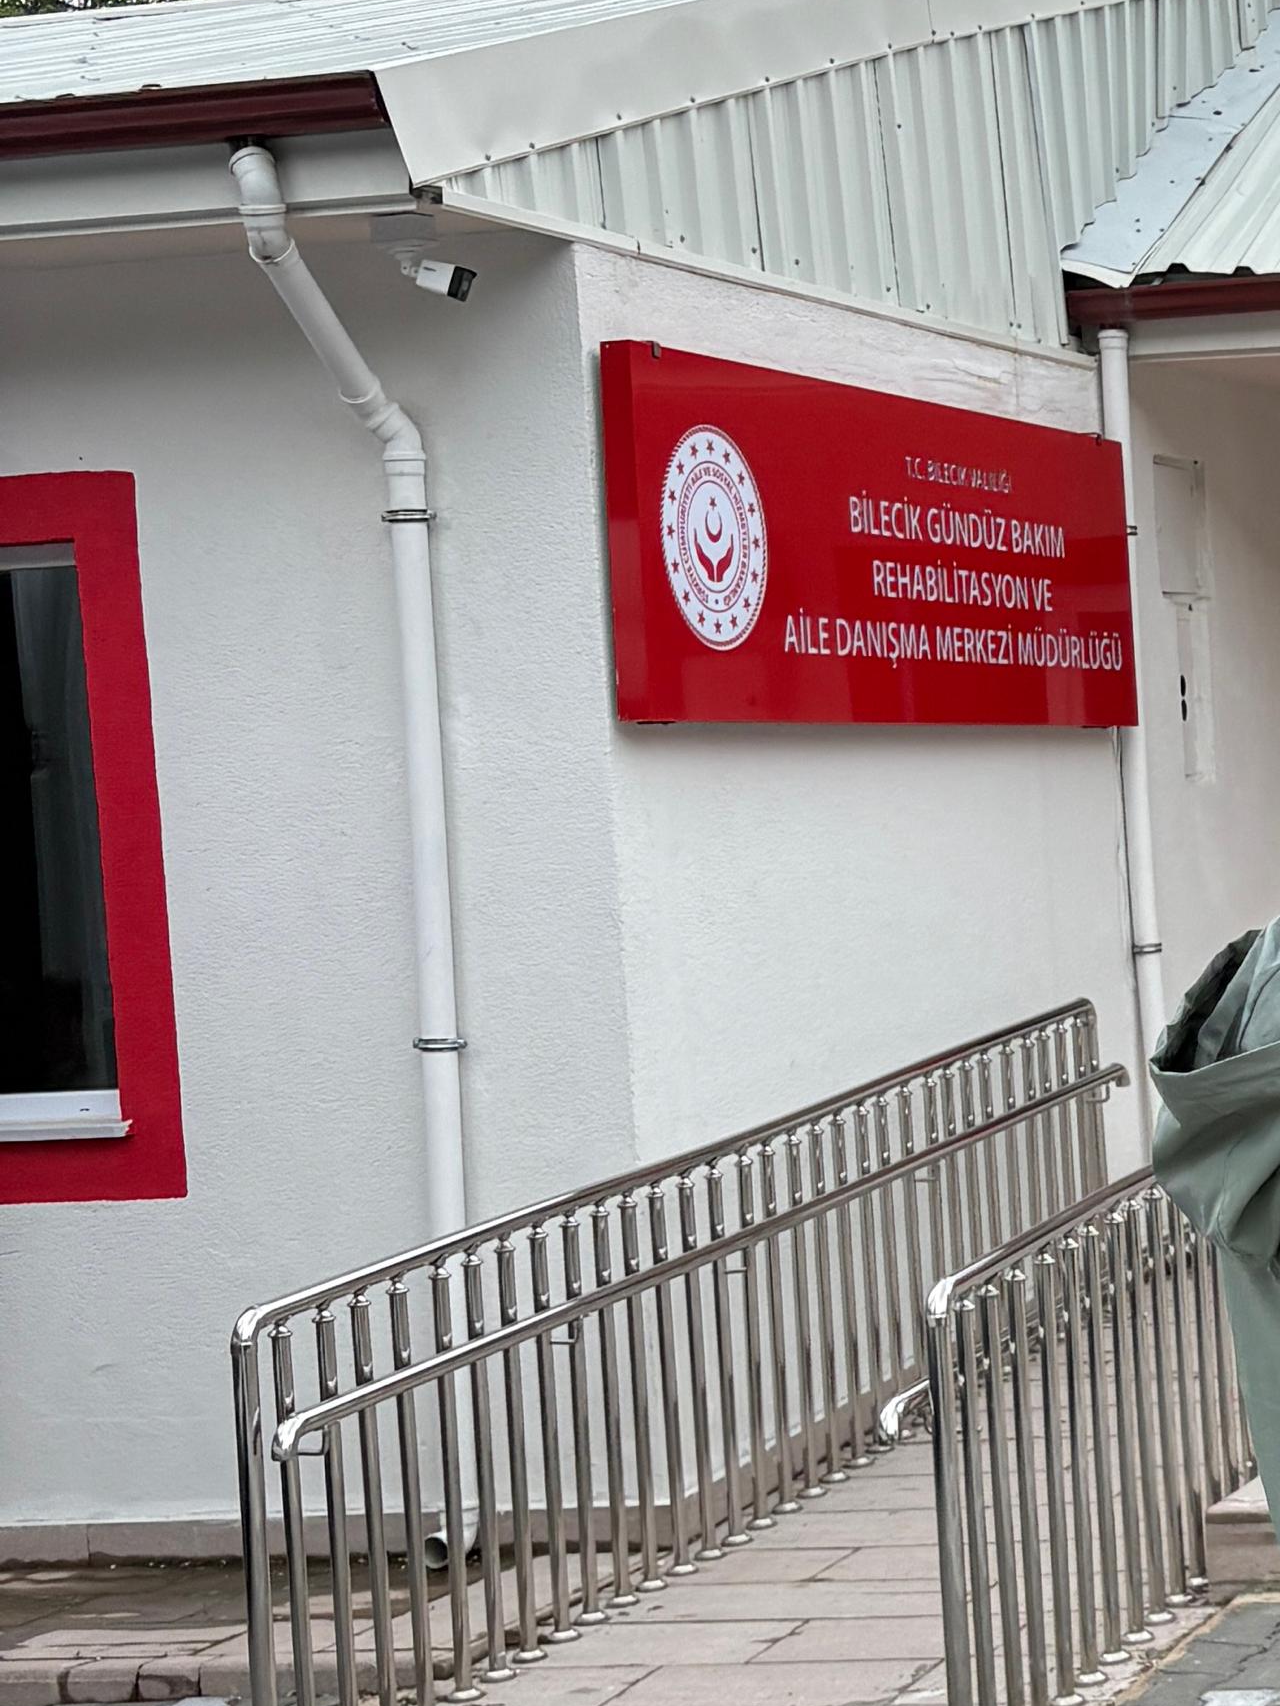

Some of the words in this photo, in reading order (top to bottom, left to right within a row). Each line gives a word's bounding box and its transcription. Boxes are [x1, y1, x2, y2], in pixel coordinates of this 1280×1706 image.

[905, 456, 926, 480] T.C.
[849, 490, 922, 541] BİLECİK
[927, 503, 1008, 552] GÜNDÜZ
[1012, 522, 1066, 559] BAKIM
[872, 559, 1028, 611] REHABİLİTASYON
[1031, 578, 1053, 612] VE
[785, 607, 831, 655] AİLE
[836, 617, 931, 669] DANIŞMA
[936, 623, 1014, 665] MERKEZİ
[1018, 626, 1122, 671] MÜDÜRLÜĞÜ
